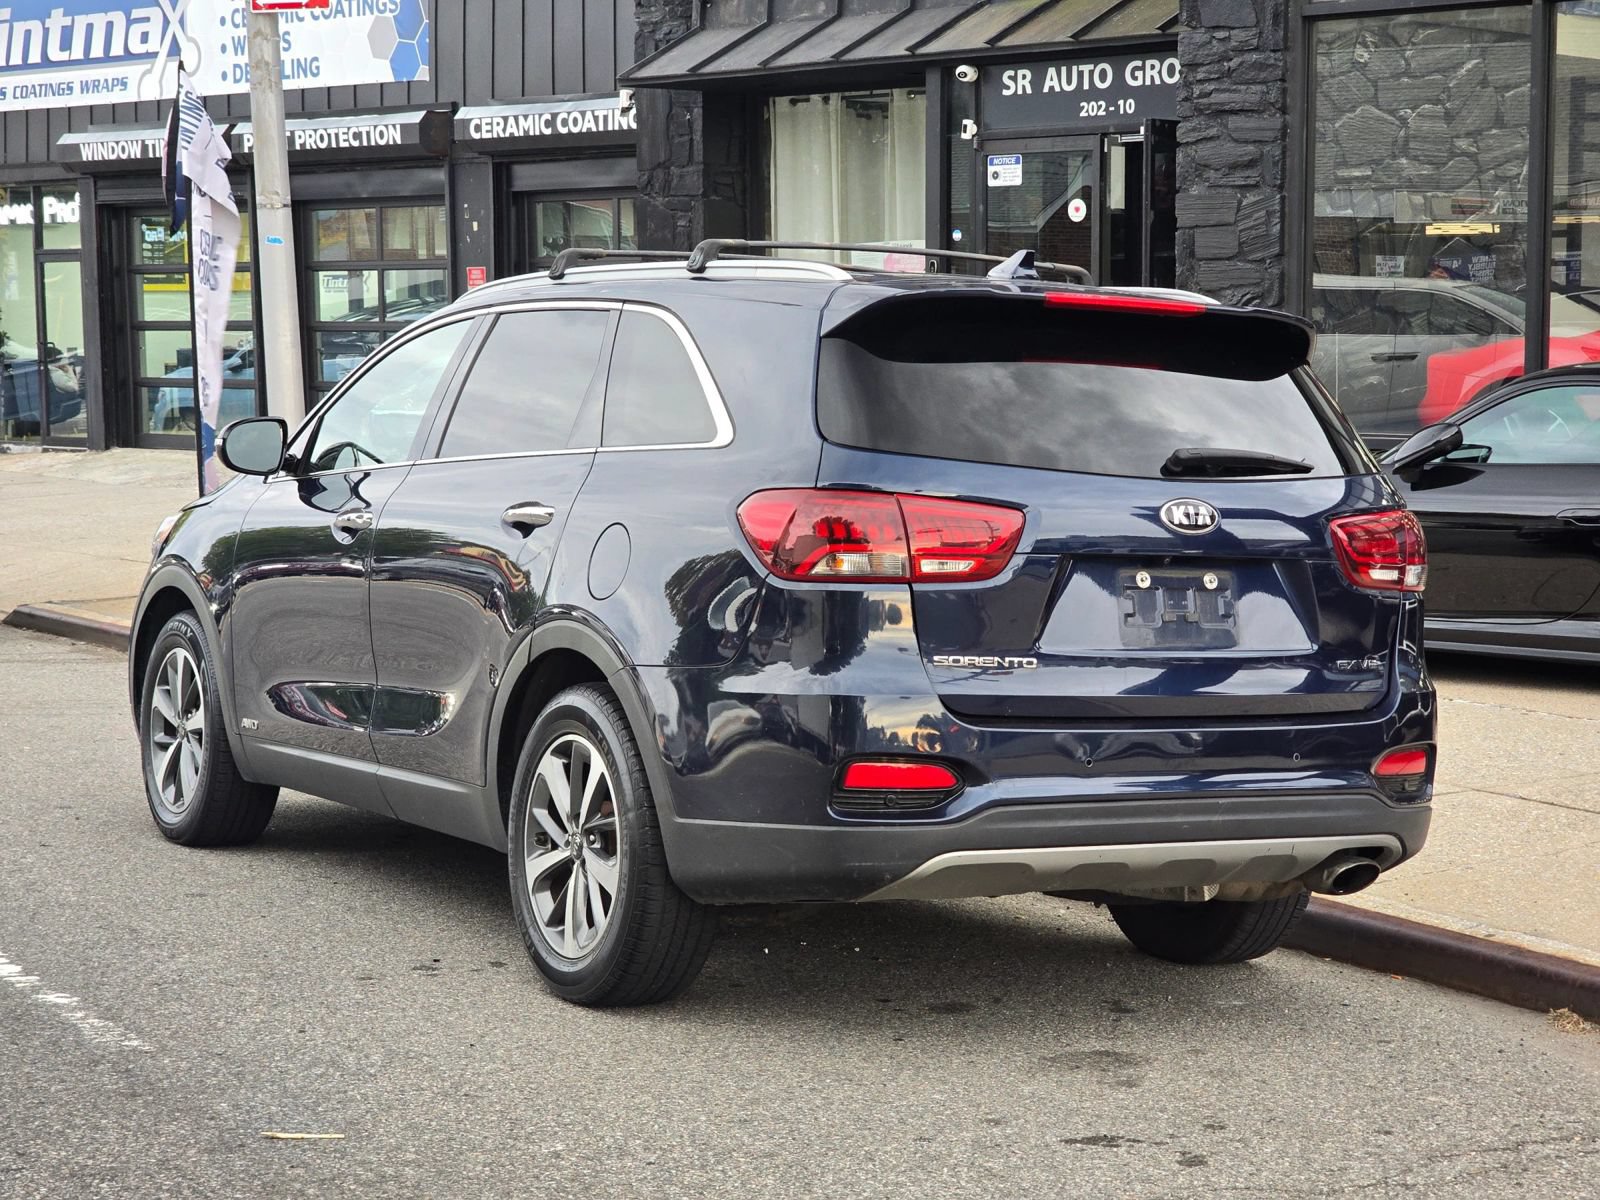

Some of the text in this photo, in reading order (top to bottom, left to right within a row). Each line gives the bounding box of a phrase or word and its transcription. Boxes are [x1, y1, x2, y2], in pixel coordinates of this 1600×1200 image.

[13, 81, 74, 100] COATINGS
[80, 77, 128, 94] WRAPS
[1002, 69, 1032, 96] SR
[1043, 63, 1113, 93] AUTO
[294, 124, 401, 150] PROTECTION
[469, 113, 552, 140] CERAMIC
[80, 139, 142, 161] WINDOW
[993, 157, 1017, 165] NOTICE
[1170, 505, 1212, 526] KIA
[932, 655, 1038, 668] SORENTO
